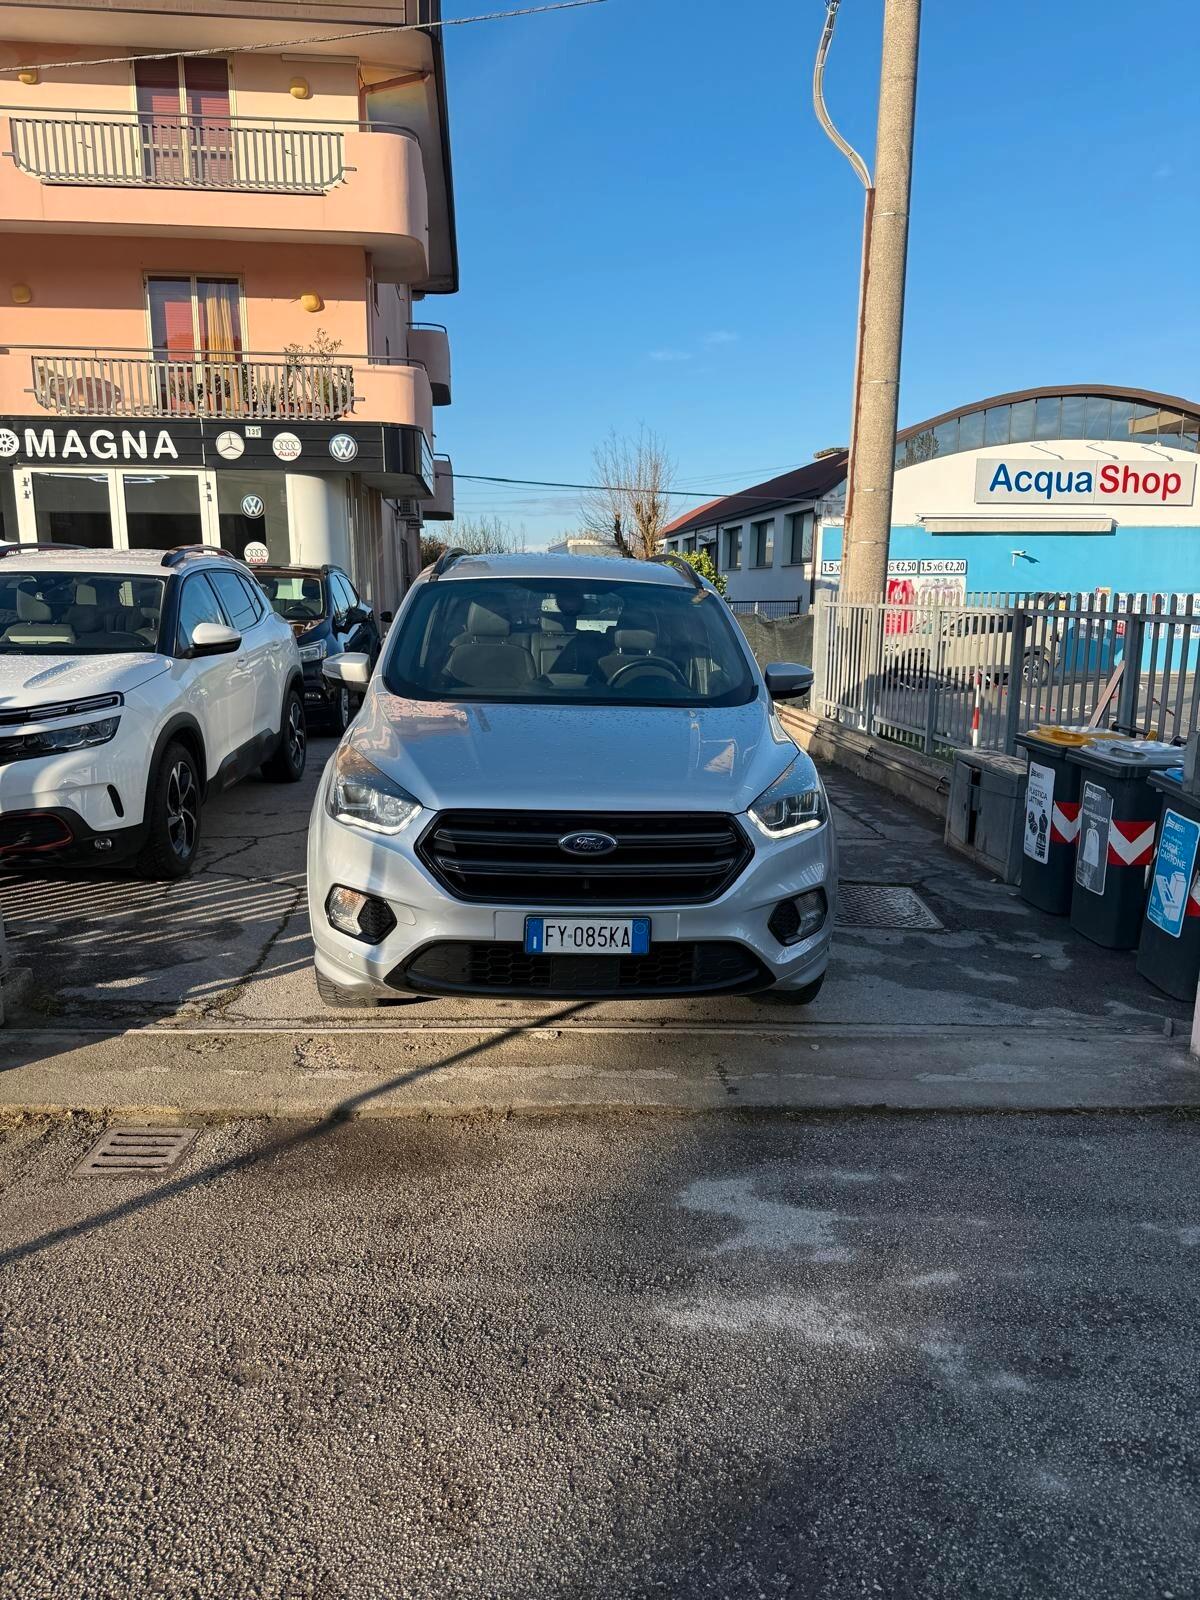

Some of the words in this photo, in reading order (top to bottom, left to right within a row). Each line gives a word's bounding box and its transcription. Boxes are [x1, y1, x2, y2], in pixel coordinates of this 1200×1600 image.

[989, 462, 1093, 500] Acqua
[1099, 464, 1182, 501] Shop
[896, 561, 917, 573] €2,50
[921, 561, 932, 572] 1,5
[945, 561, 965, 573] €2,20
[573, 836, 604, 851] Ford
